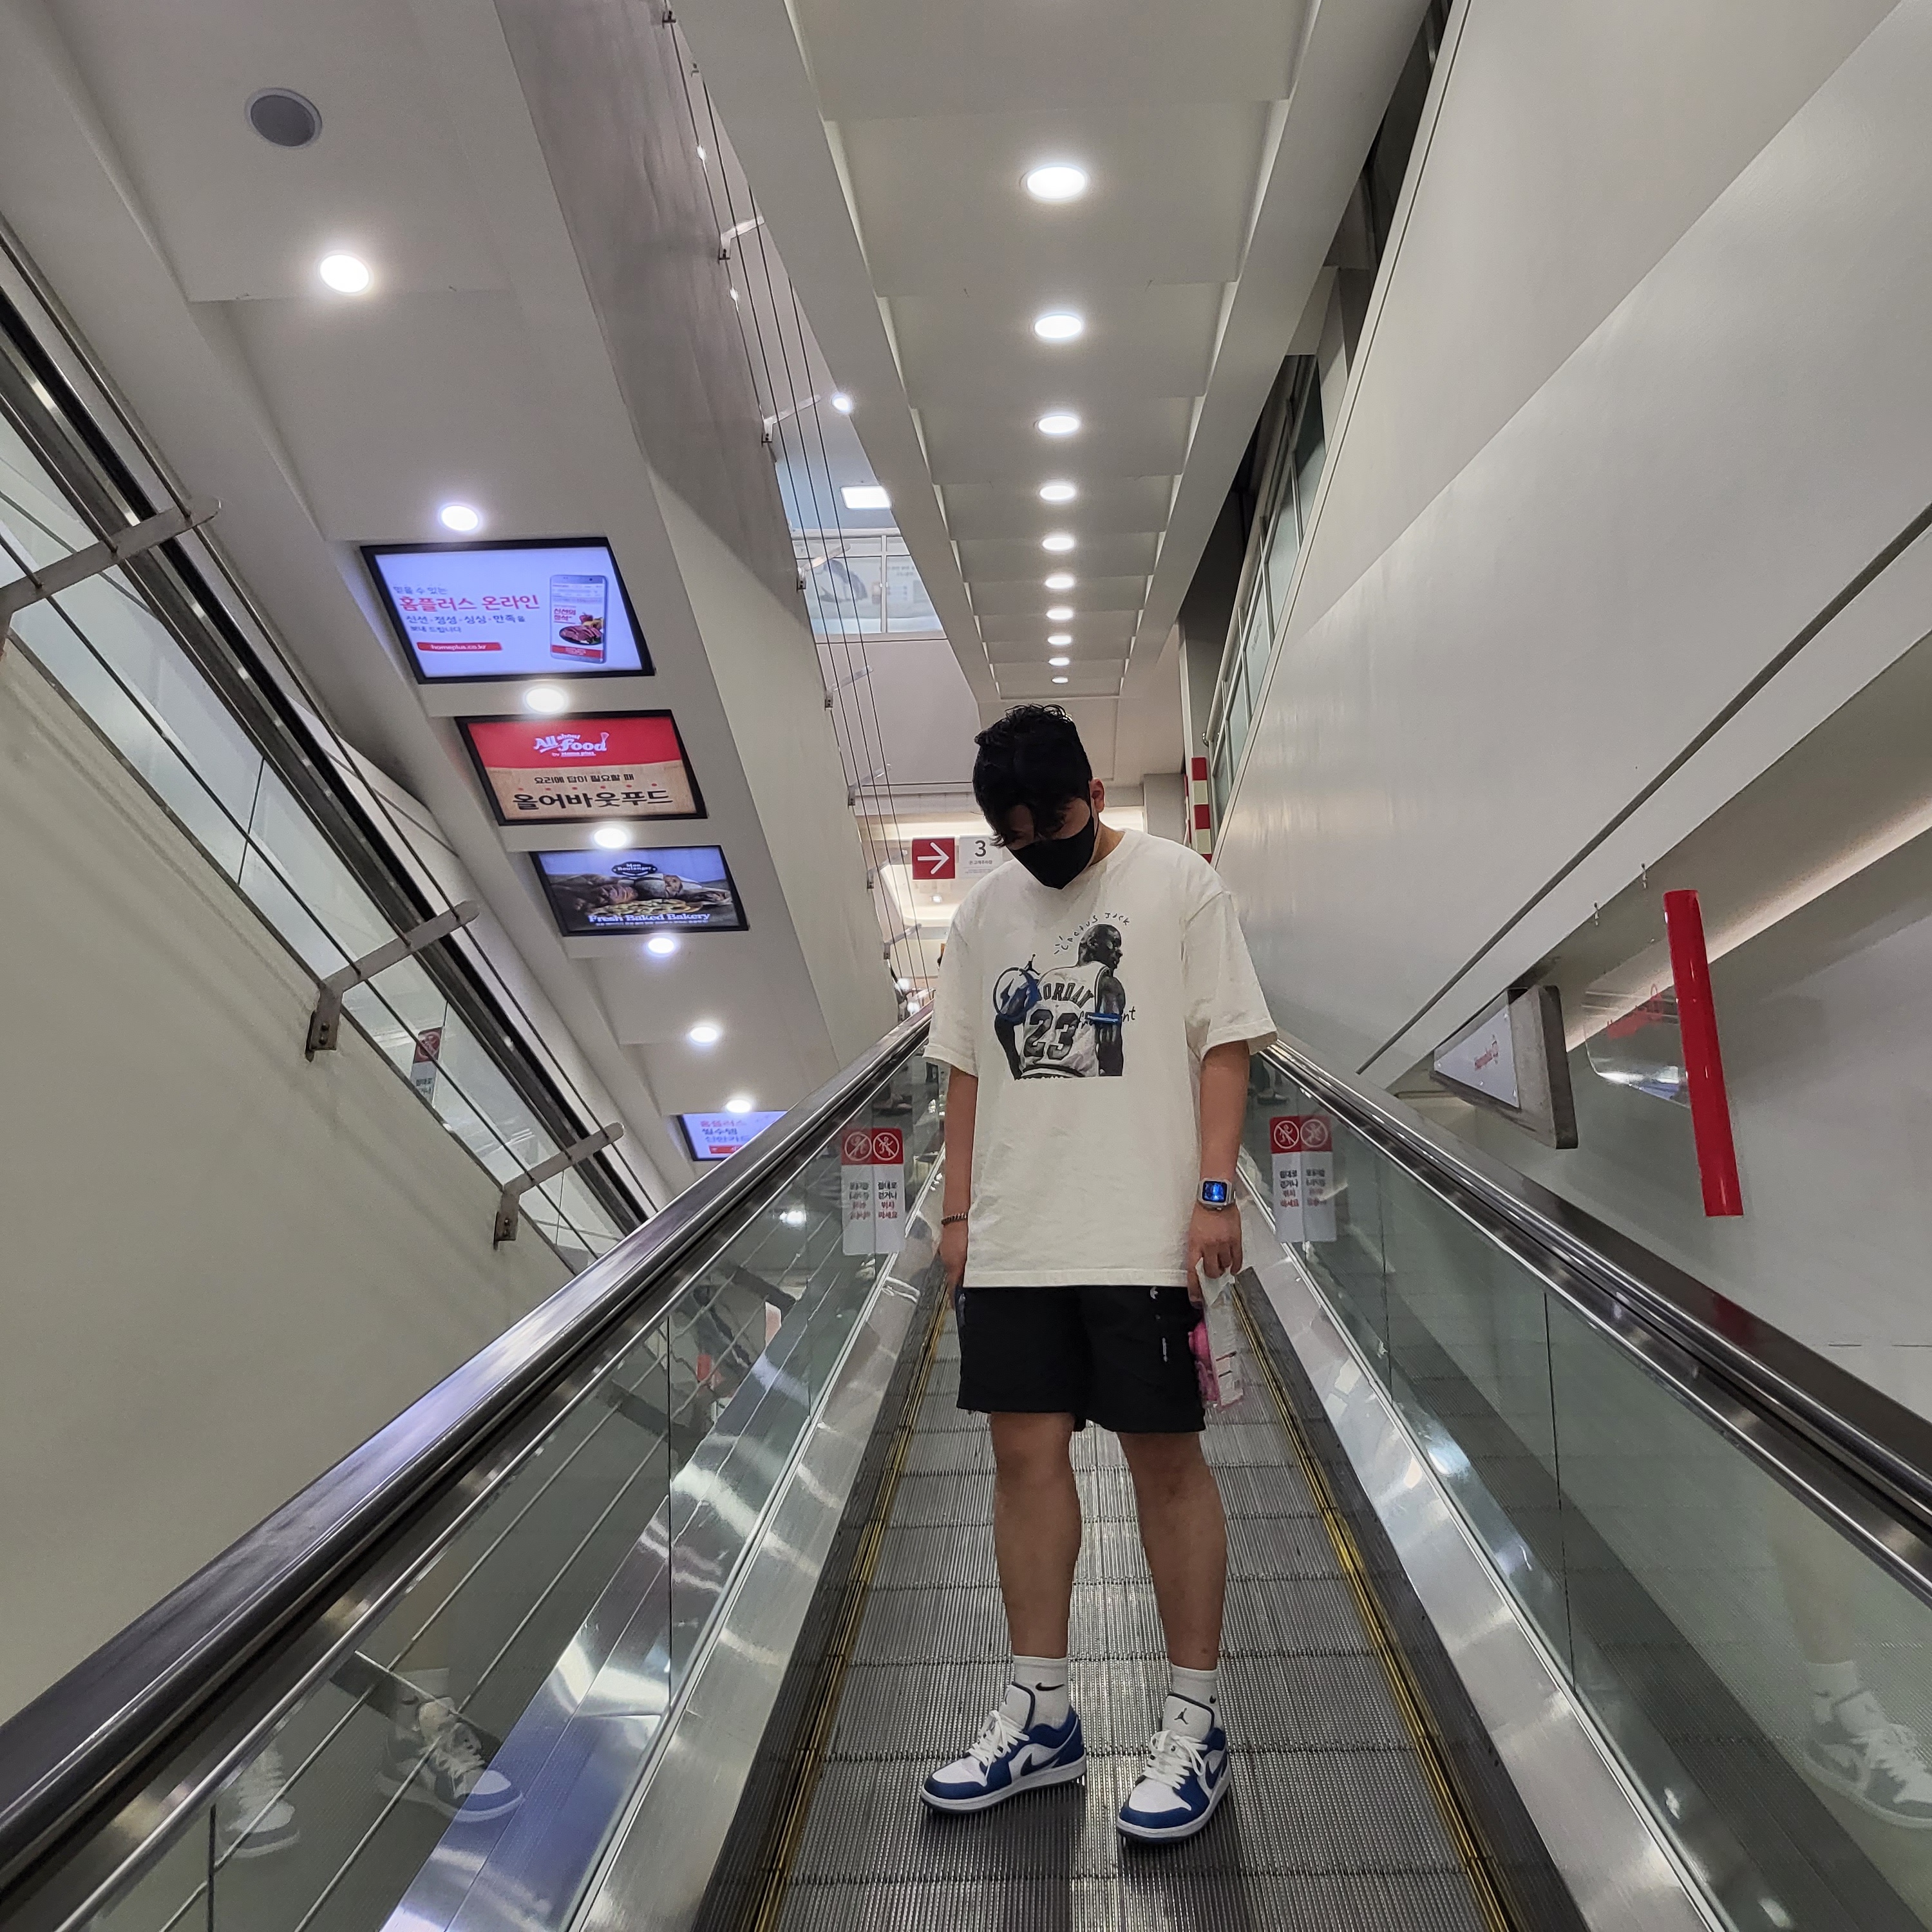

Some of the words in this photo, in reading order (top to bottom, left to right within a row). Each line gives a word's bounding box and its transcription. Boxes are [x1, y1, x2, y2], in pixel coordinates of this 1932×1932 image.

[399, 596, 477, 612] 홈플러스
[482, 594, 540, 611] 온라인
[533, 735, 558, 750] All
[534, 775, 565, 784] 요리에
[567, 775, 588, 783] 답이
[591, 774, 620, 782] 필요할
[623, 773, 635, 782] 때
[513, 790, 673, 810] 올어바웃푸드
[974, 840, 987, 857] 3
[588, 914, 623, 923] Fresh
[667, 913, 710, 922] Bakery
[1043, 983, 1094, 1009] ORDAN
[1023, 1009, 1080, 1061] 23
[878, 1191, 897, 1200] 걷거나
[878, 1211, 898, 1220] 마세요
